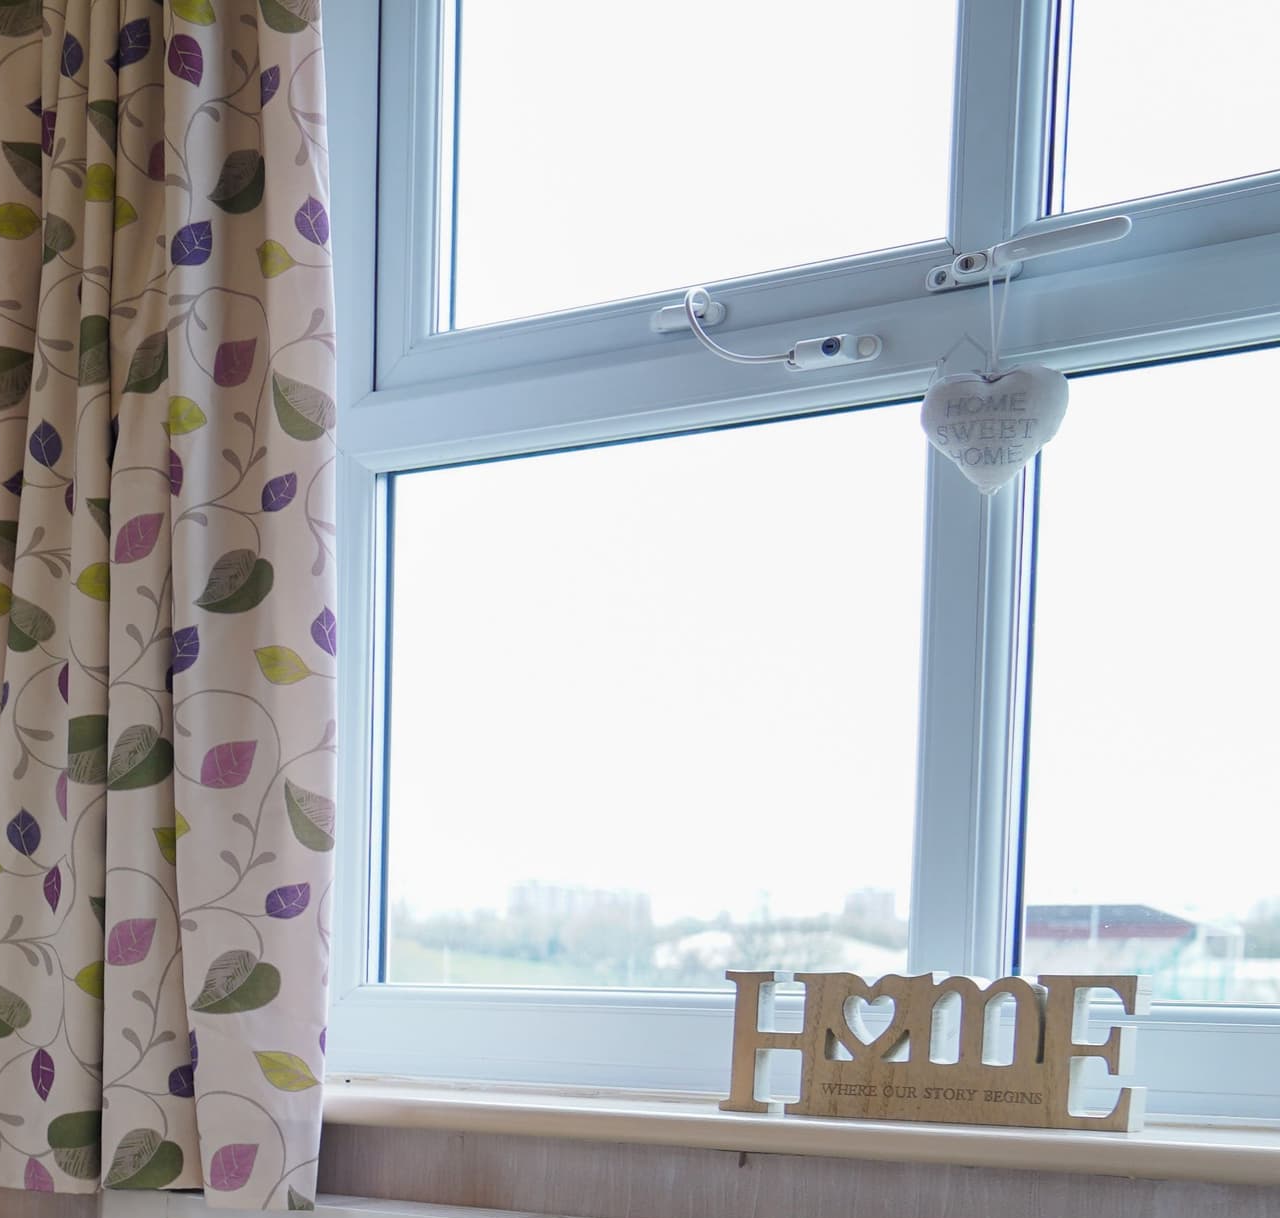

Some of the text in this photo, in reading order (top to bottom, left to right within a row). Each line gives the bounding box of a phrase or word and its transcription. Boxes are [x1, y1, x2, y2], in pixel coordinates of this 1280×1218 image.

[945, 392, 1027, 418] HOME
[937, 418, 1038, 445] SWEET
[822, 1082, 1043, 1105] WHERE OUR STORY BEGINS
